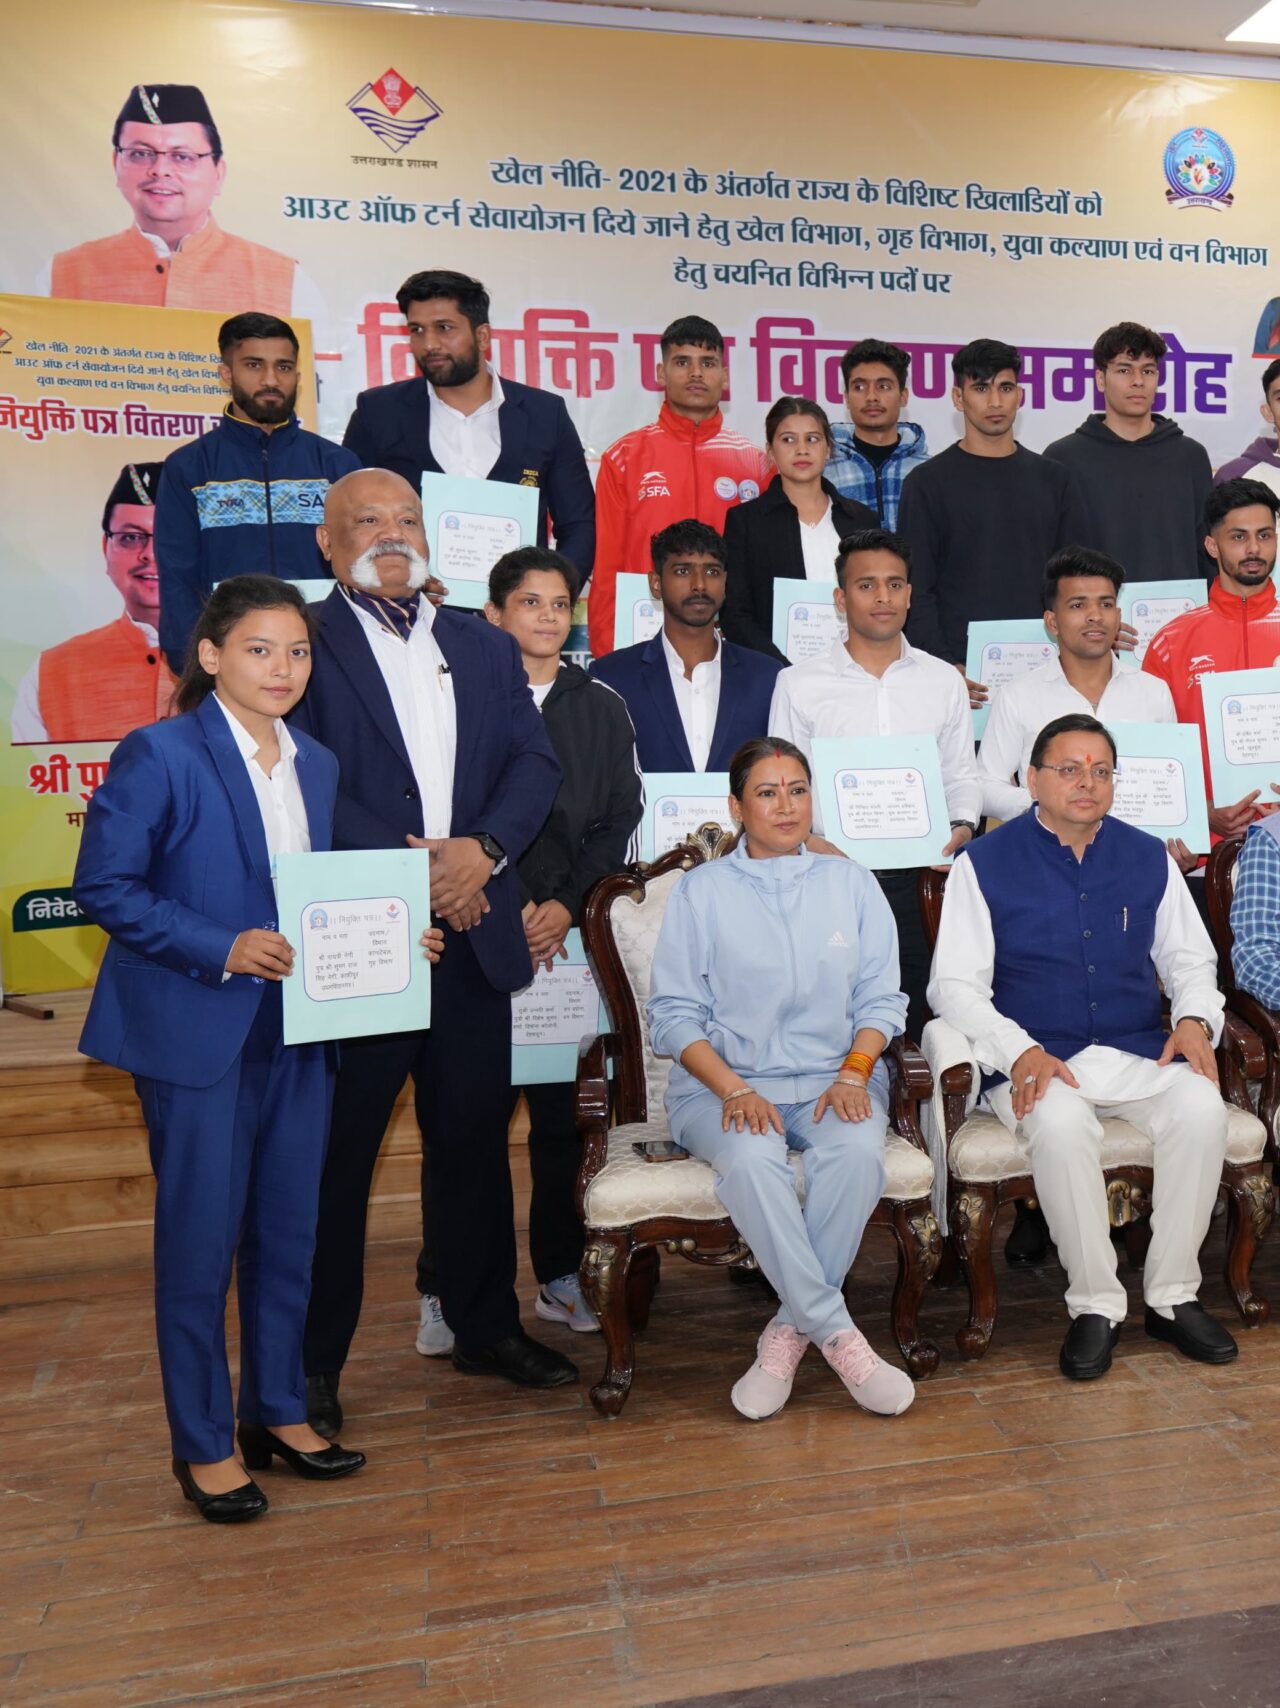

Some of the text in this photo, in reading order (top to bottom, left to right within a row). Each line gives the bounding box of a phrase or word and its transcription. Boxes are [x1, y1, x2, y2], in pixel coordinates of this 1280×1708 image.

[406, 158, 439, 169] शासन
[489, 157, 544, 186] खेल
[618, 168, 677, 193] 2021
[682, 167, 709, 195] के
[714, 170, 791, 199] अंतर्गत
[796, 179, 850, 201] राज्य
[856, 177, 880, 204] के
[885, 178, 959, 209] विशिष्ट
[965, 183, 1071, 215] खिलाडियों
[1074, 191, 1103, 216] को
[283, 195, 1268, 267] आउट ऑफ टर्न सेवायोजन दिये जाने हेतु खेल विभाग, गृह विभाग, युवा कल्याण एवं वन विभाग
[673, 256, 952, 294] हेतु चयनित विभिन्न पदों पर
[15, 357, 38, 367] आउट
[26, 340, 45, 351] खेल
[75, 345, 97, 355] 2021
[100, 346, 109, 356] के
[167, 350, 176, 360] के
[80, 409, 119, 434] पत्र
[123, 404, 205, 437] वितरण
[298, 494, 325, 508] SA
[646, 486, 671, 497] SFA
[29, 754, 71, 794] श्री
